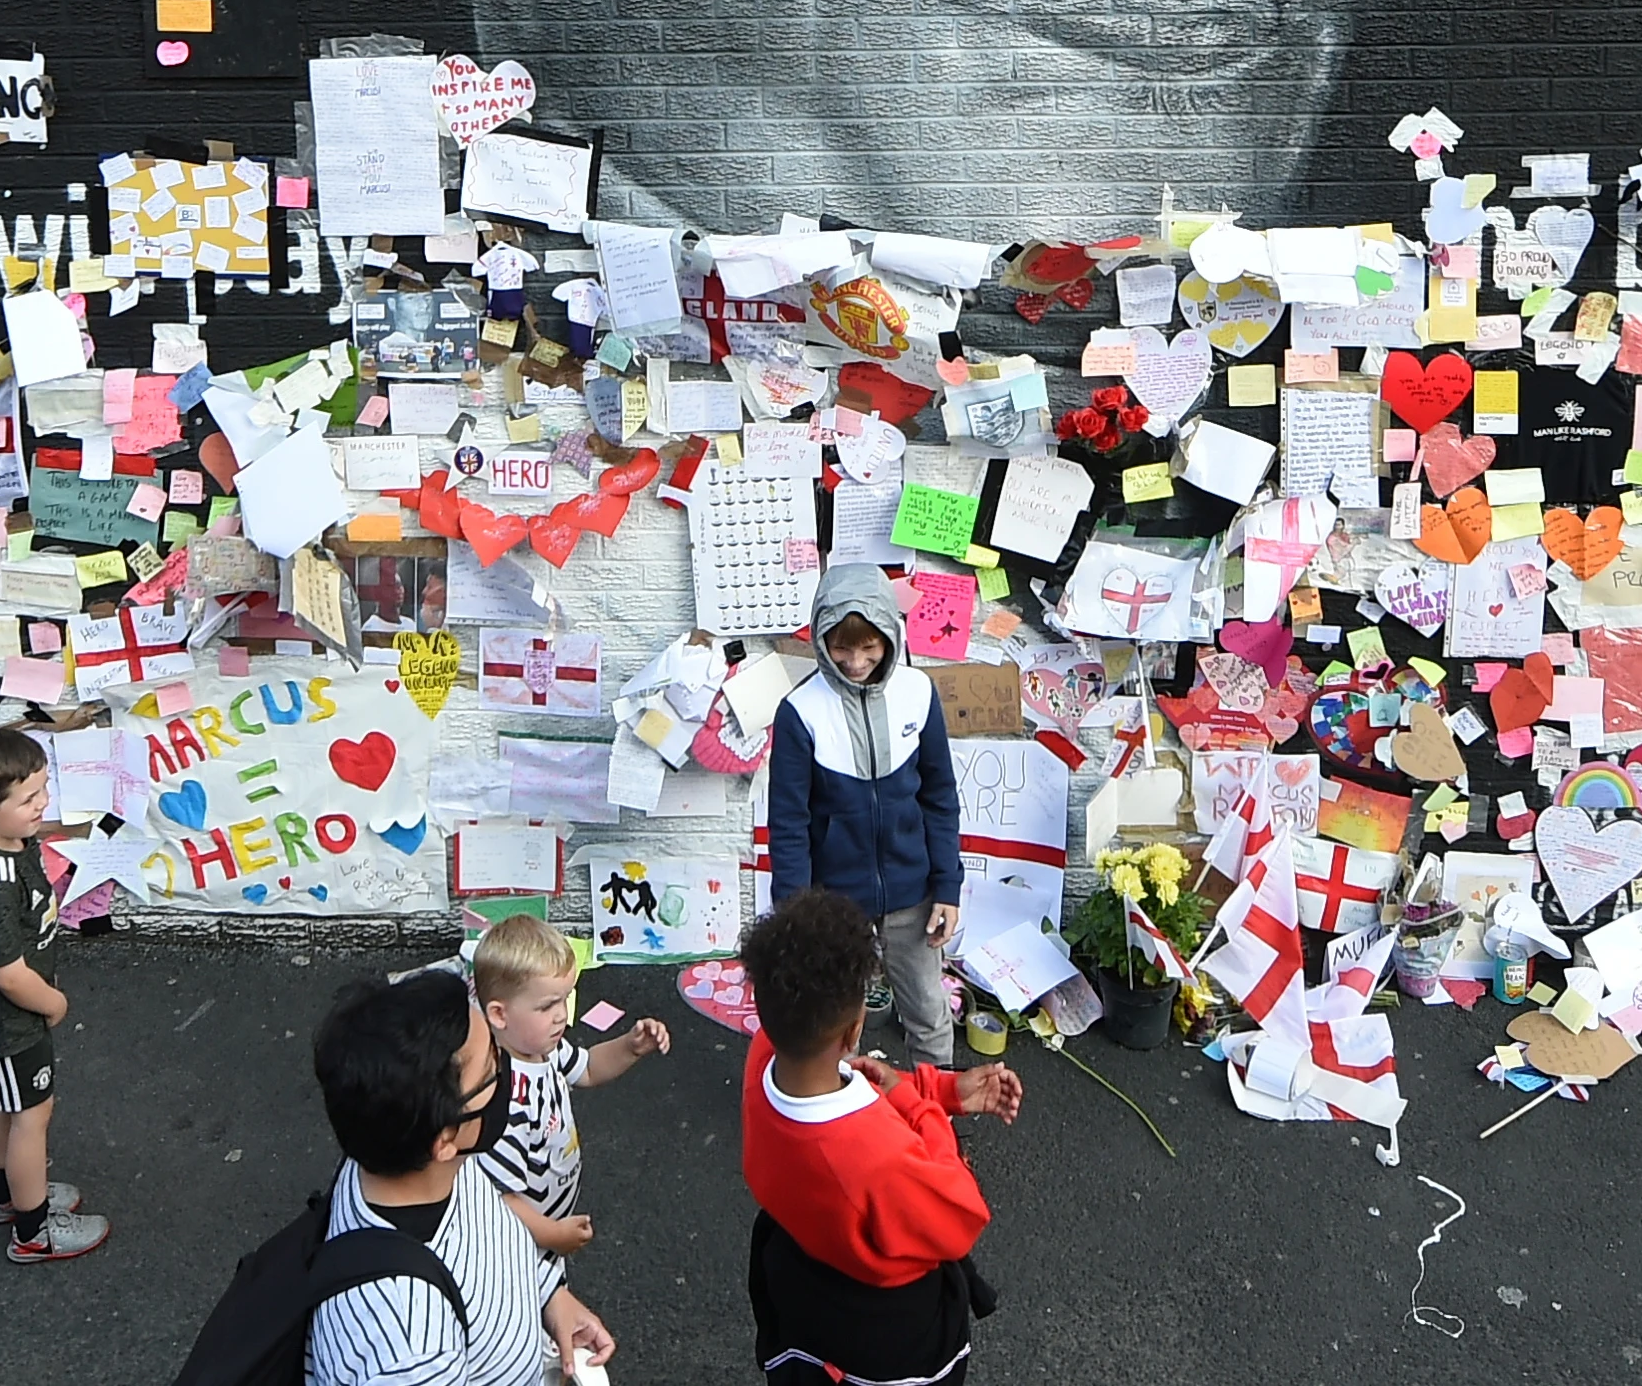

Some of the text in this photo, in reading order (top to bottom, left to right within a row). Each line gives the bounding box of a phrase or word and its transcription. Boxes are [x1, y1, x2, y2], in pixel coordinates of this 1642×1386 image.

[432, 77, 533, 97] INSPIRE ME
[473, 94, 526, 111] MANY
[451, 110, 510, 133] OTHERS
[686, 299, 779, 322] GLAND
[1539, 340, 1585, 351] LEGEND
[1533, 426, 1612, 437] MAN LIKE RASHFORD
[349, 441, 407, 452] MANCHESTER
[46, 470, 72, 489] THIS
[491, 460, 550, 489] HERO
[78, 490, 86, 501] A
[44, 503, 105, 518] THIS IS A
[1387, 581, 1422, 603] LOVE
[80, 612, 177, 644] HERO BRAVE
[1459, 620, 1522, 632] RESPECT
[398, 659, 458, 677] LEGEND
[143, 676, 338, 783] MARCUS
[957, 748, 1026, 790] YOU
[1218, 782, 1314, 805] MCUS
[957, 786, 1021, 826] ARE
[1213, 796, 1317, 833] RFORD
[181, 812, 358, 891] HERO
